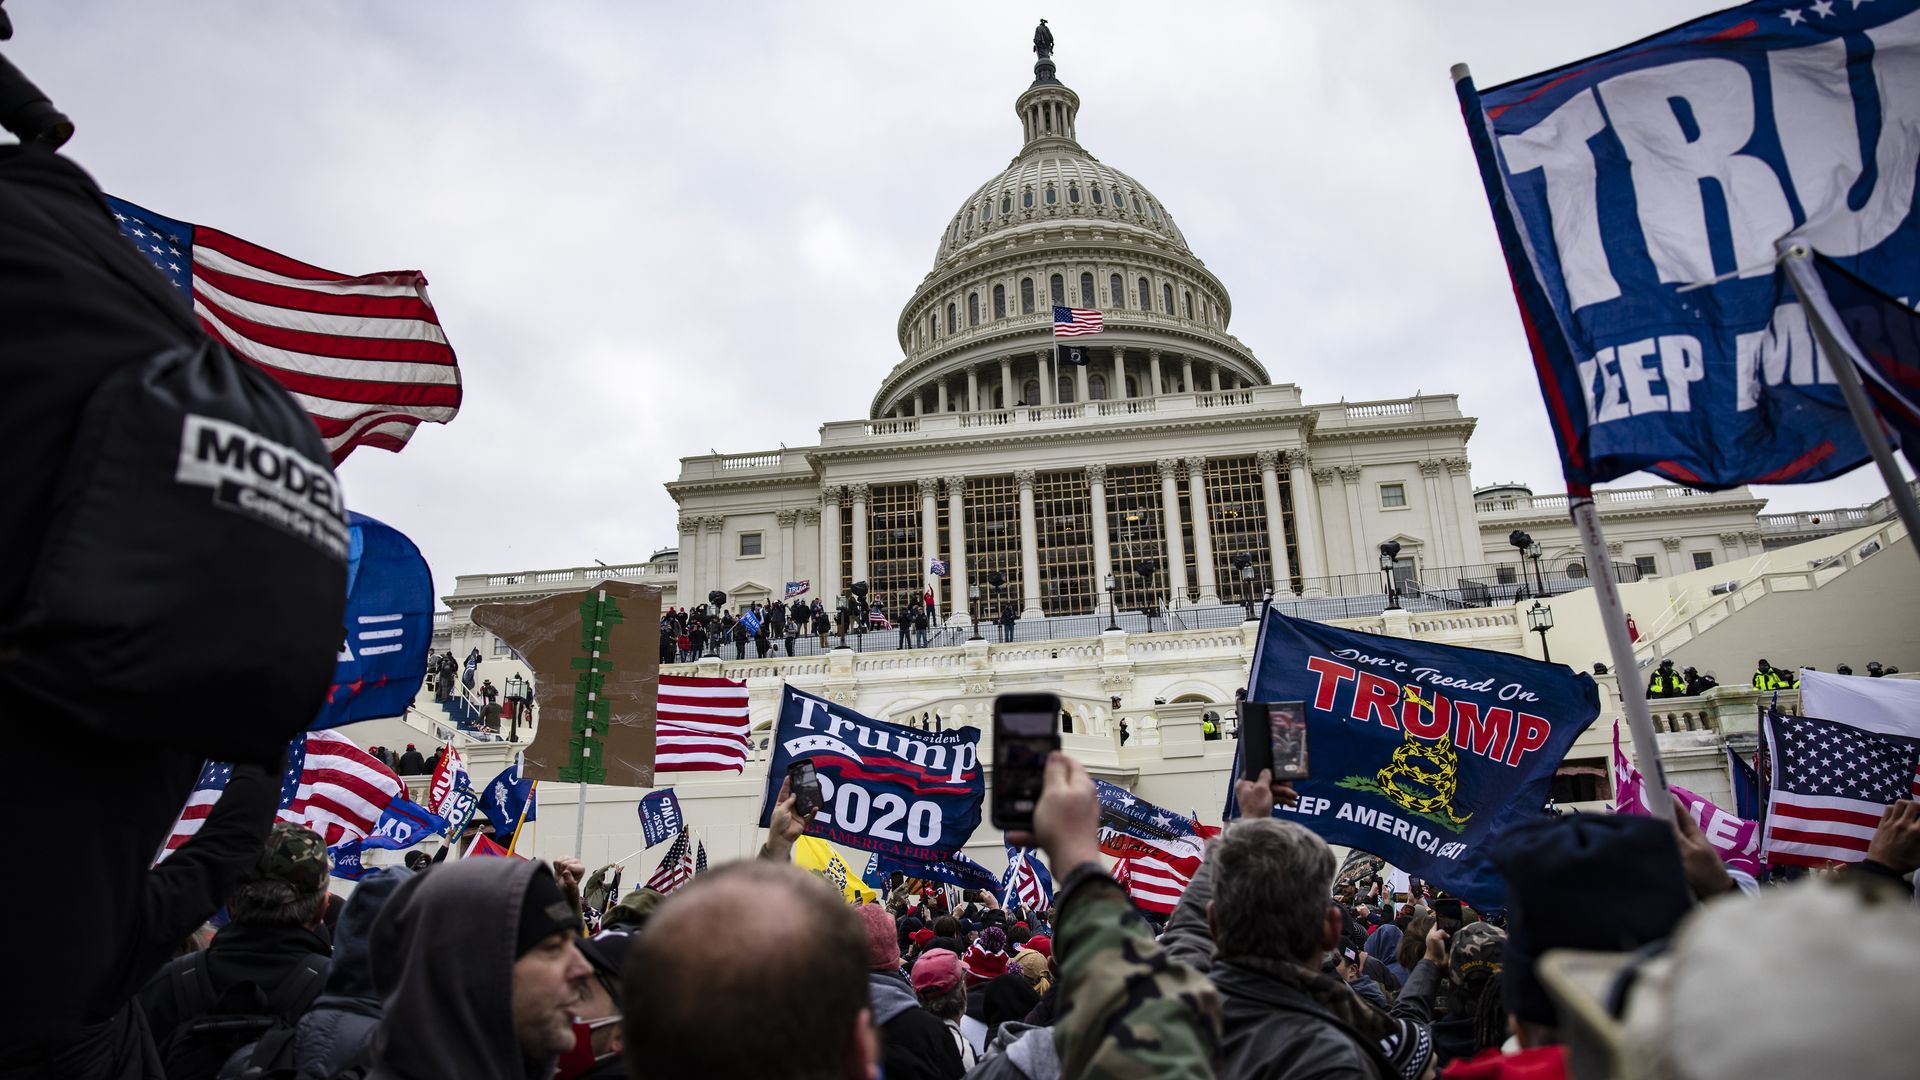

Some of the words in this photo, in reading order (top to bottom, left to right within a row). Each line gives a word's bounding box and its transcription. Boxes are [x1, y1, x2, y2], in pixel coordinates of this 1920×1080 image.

[1330, 649, 1407, 673] Don't
[1411, 667, 1494, 695] Tread
[1497, 683, 1540, 703] On
[791, 692, 977, 785] Trump
[1307, 655, 1551, 768] TRUMP
[827, 828, 900, 856] AMERICA
[904, 846, 949, 863] FIRST
[1335, 802, 1440, 855] AMERICA
